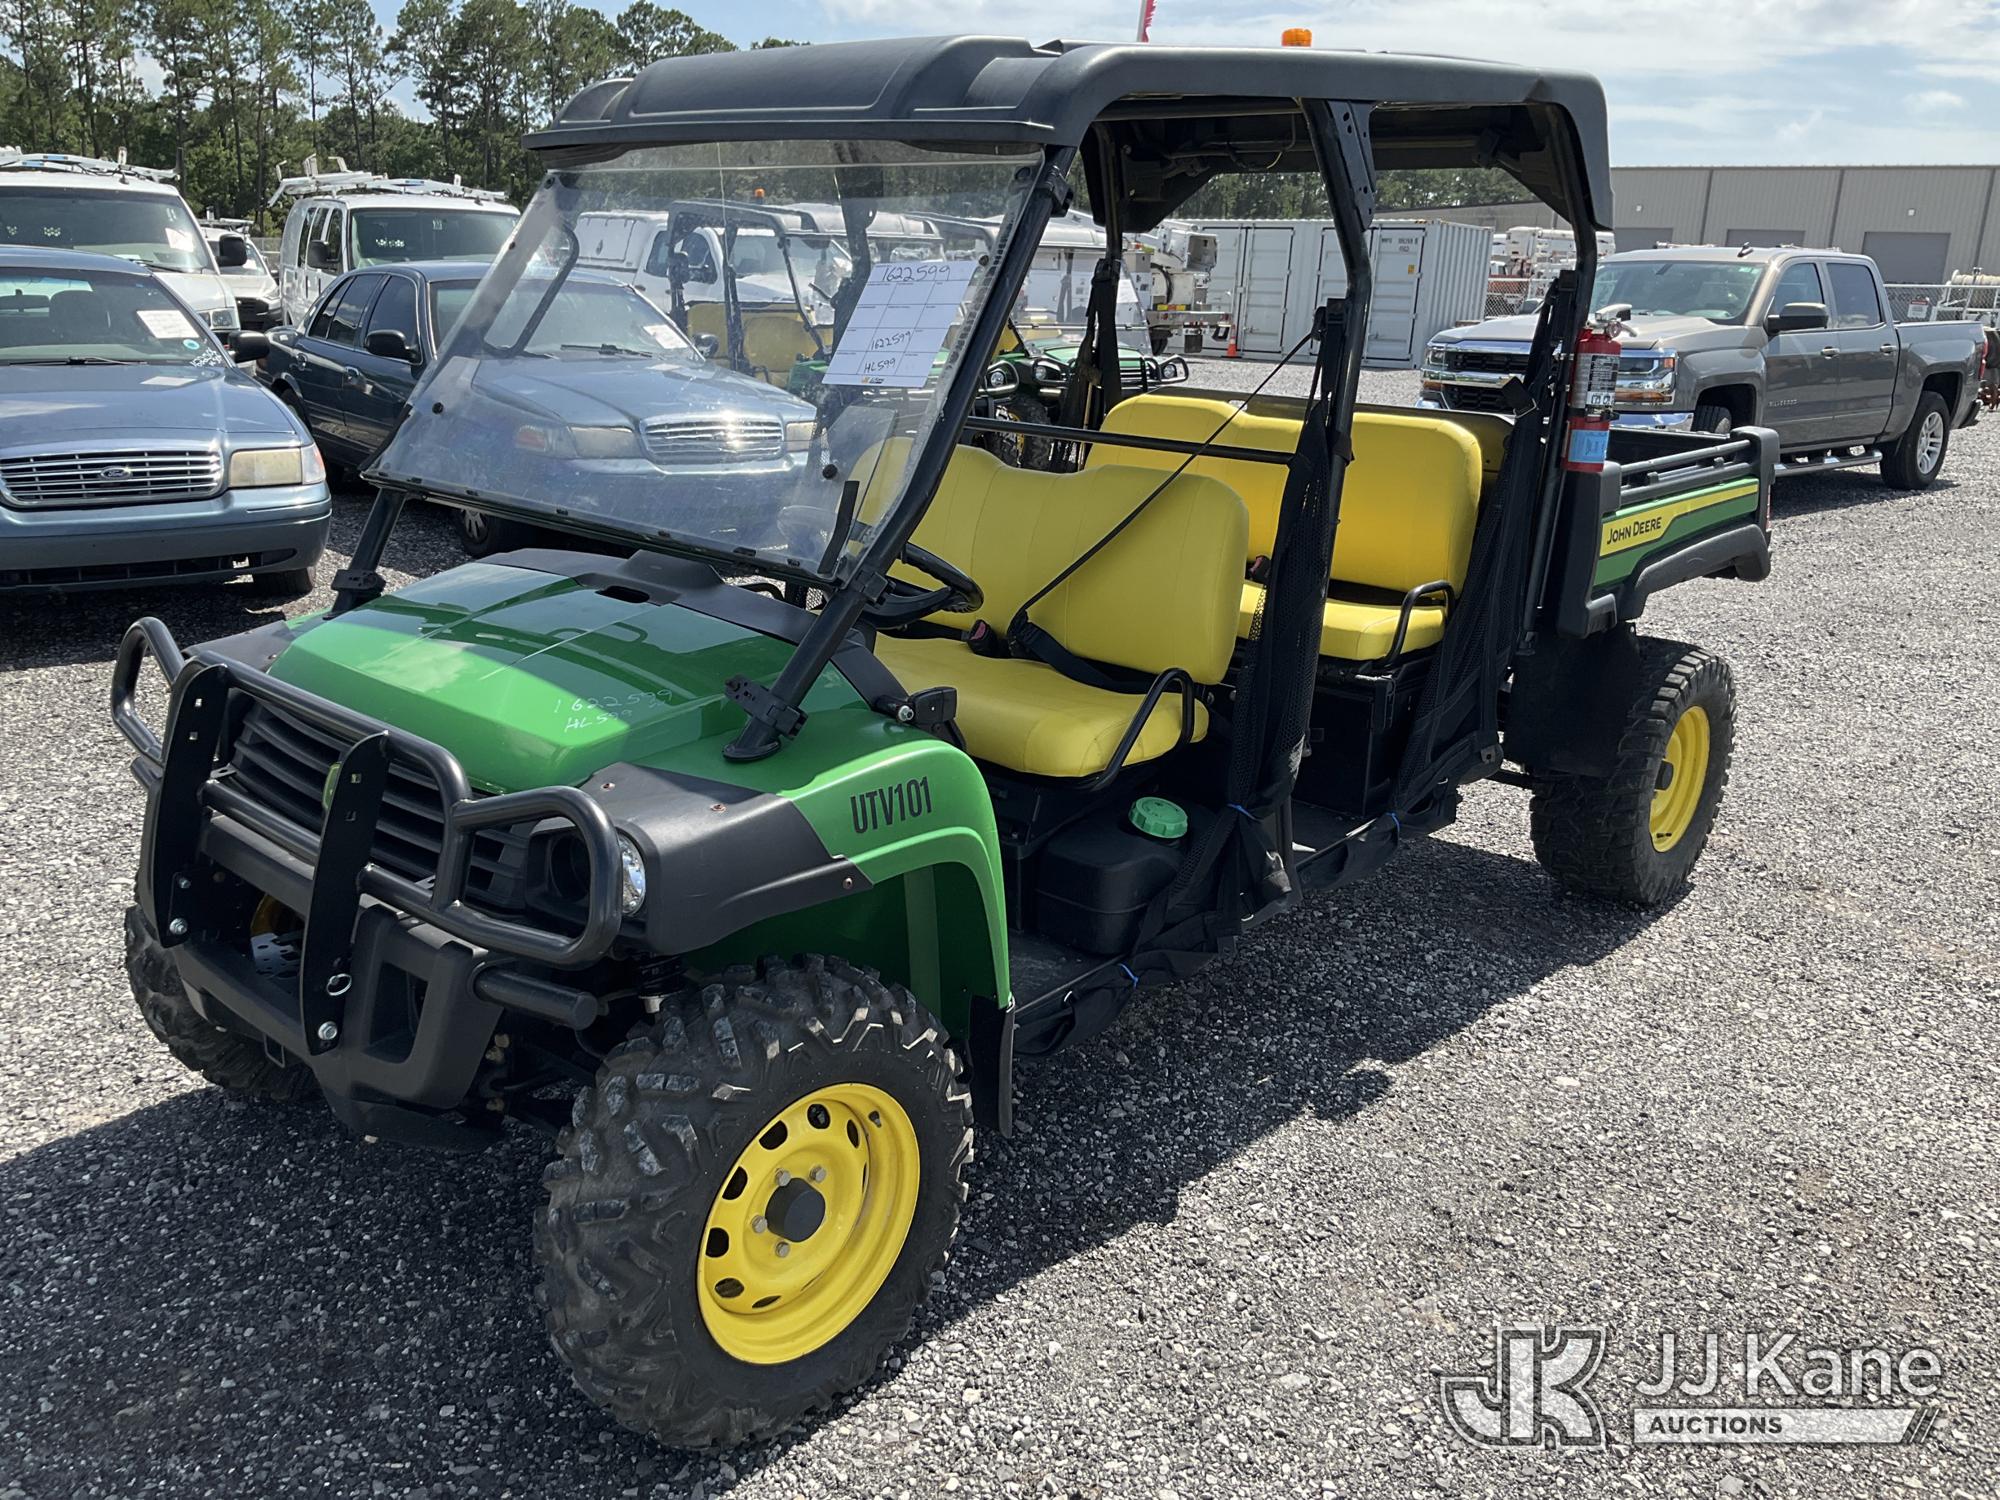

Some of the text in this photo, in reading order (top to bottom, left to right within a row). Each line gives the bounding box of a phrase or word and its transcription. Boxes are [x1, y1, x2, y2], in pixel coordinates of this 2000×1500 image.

[882, 264, 951, 282] 1622599
[870, 330, 912, 351] 1622599
[1606, 516, 1662, 545] JOHN DEERE
[849, 775, 933, 835] UTV101
